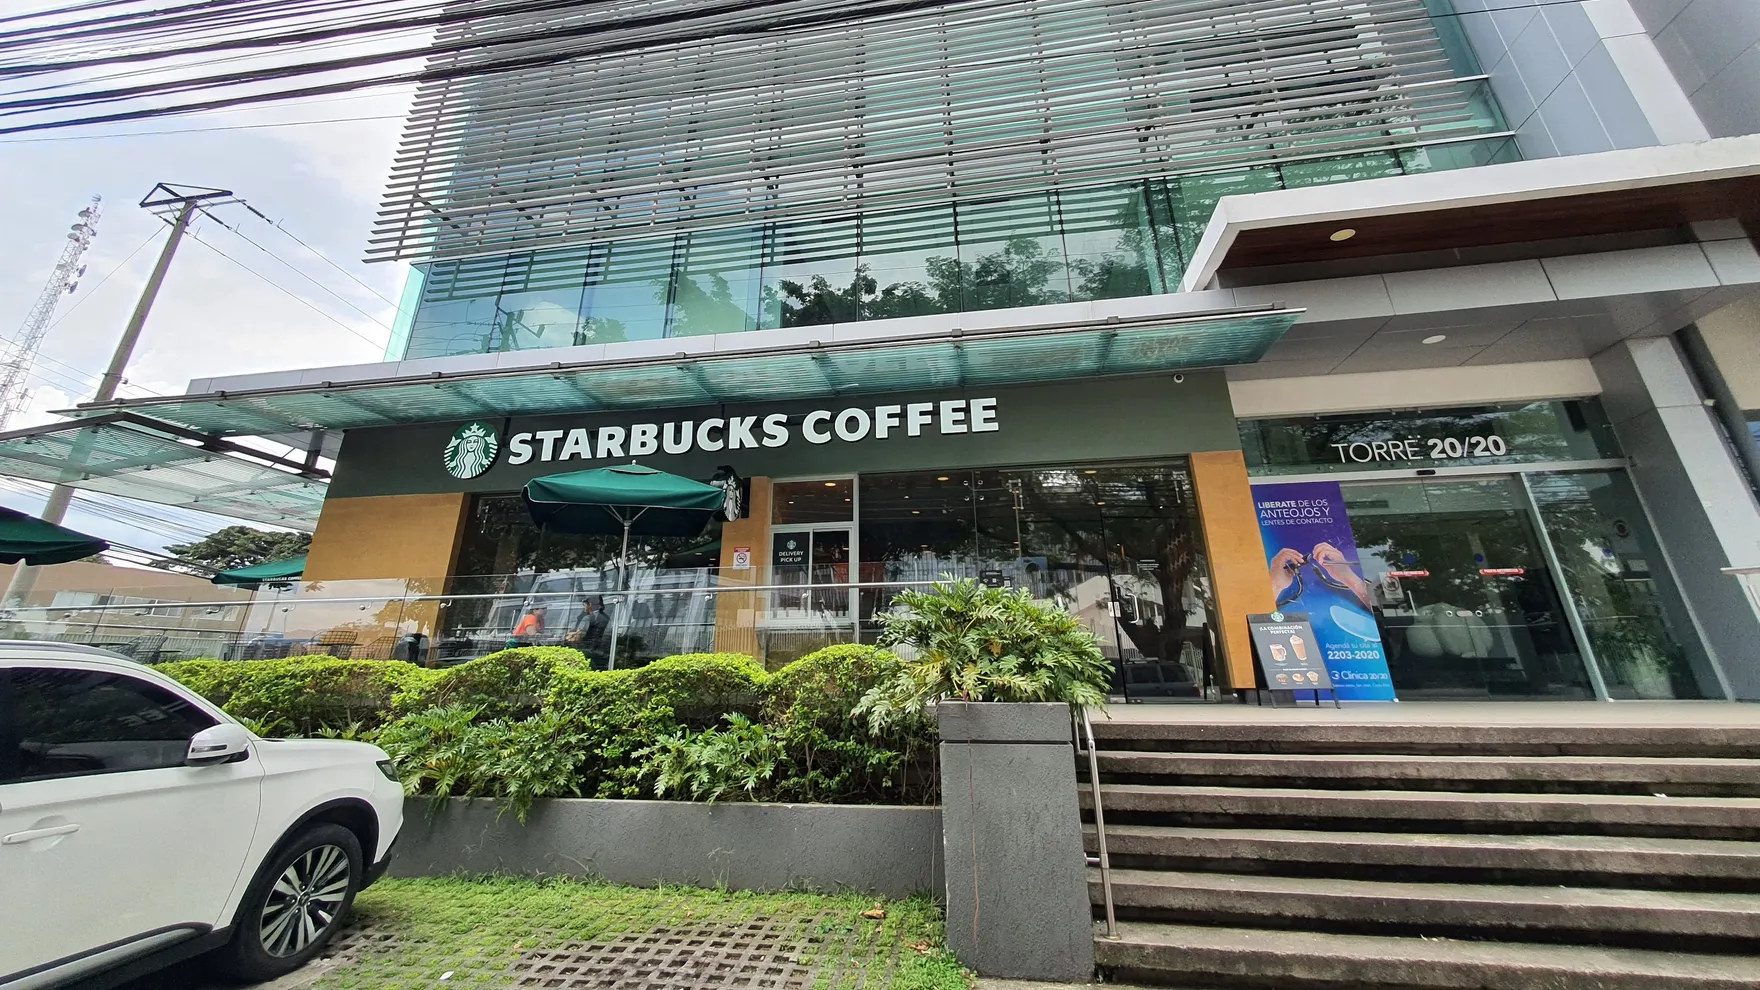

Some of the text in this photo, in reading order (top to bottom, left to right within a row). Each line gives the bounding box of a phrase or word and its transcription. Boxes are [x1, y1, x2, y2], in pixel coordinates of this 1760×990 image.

[507, 397, 999, 466] STARBUCKS COFFEE
[1330, 435, 1507, 463] TORRE 20/20
[1257, 498, 1328, 509] LIBERATE DE LOS
[1260, 506, 1330, 519] ANTEOJOS Y
[1295, 517, 1334, 525] CONTACTO
[1327, 650, 1380, 659] 2203-2020
